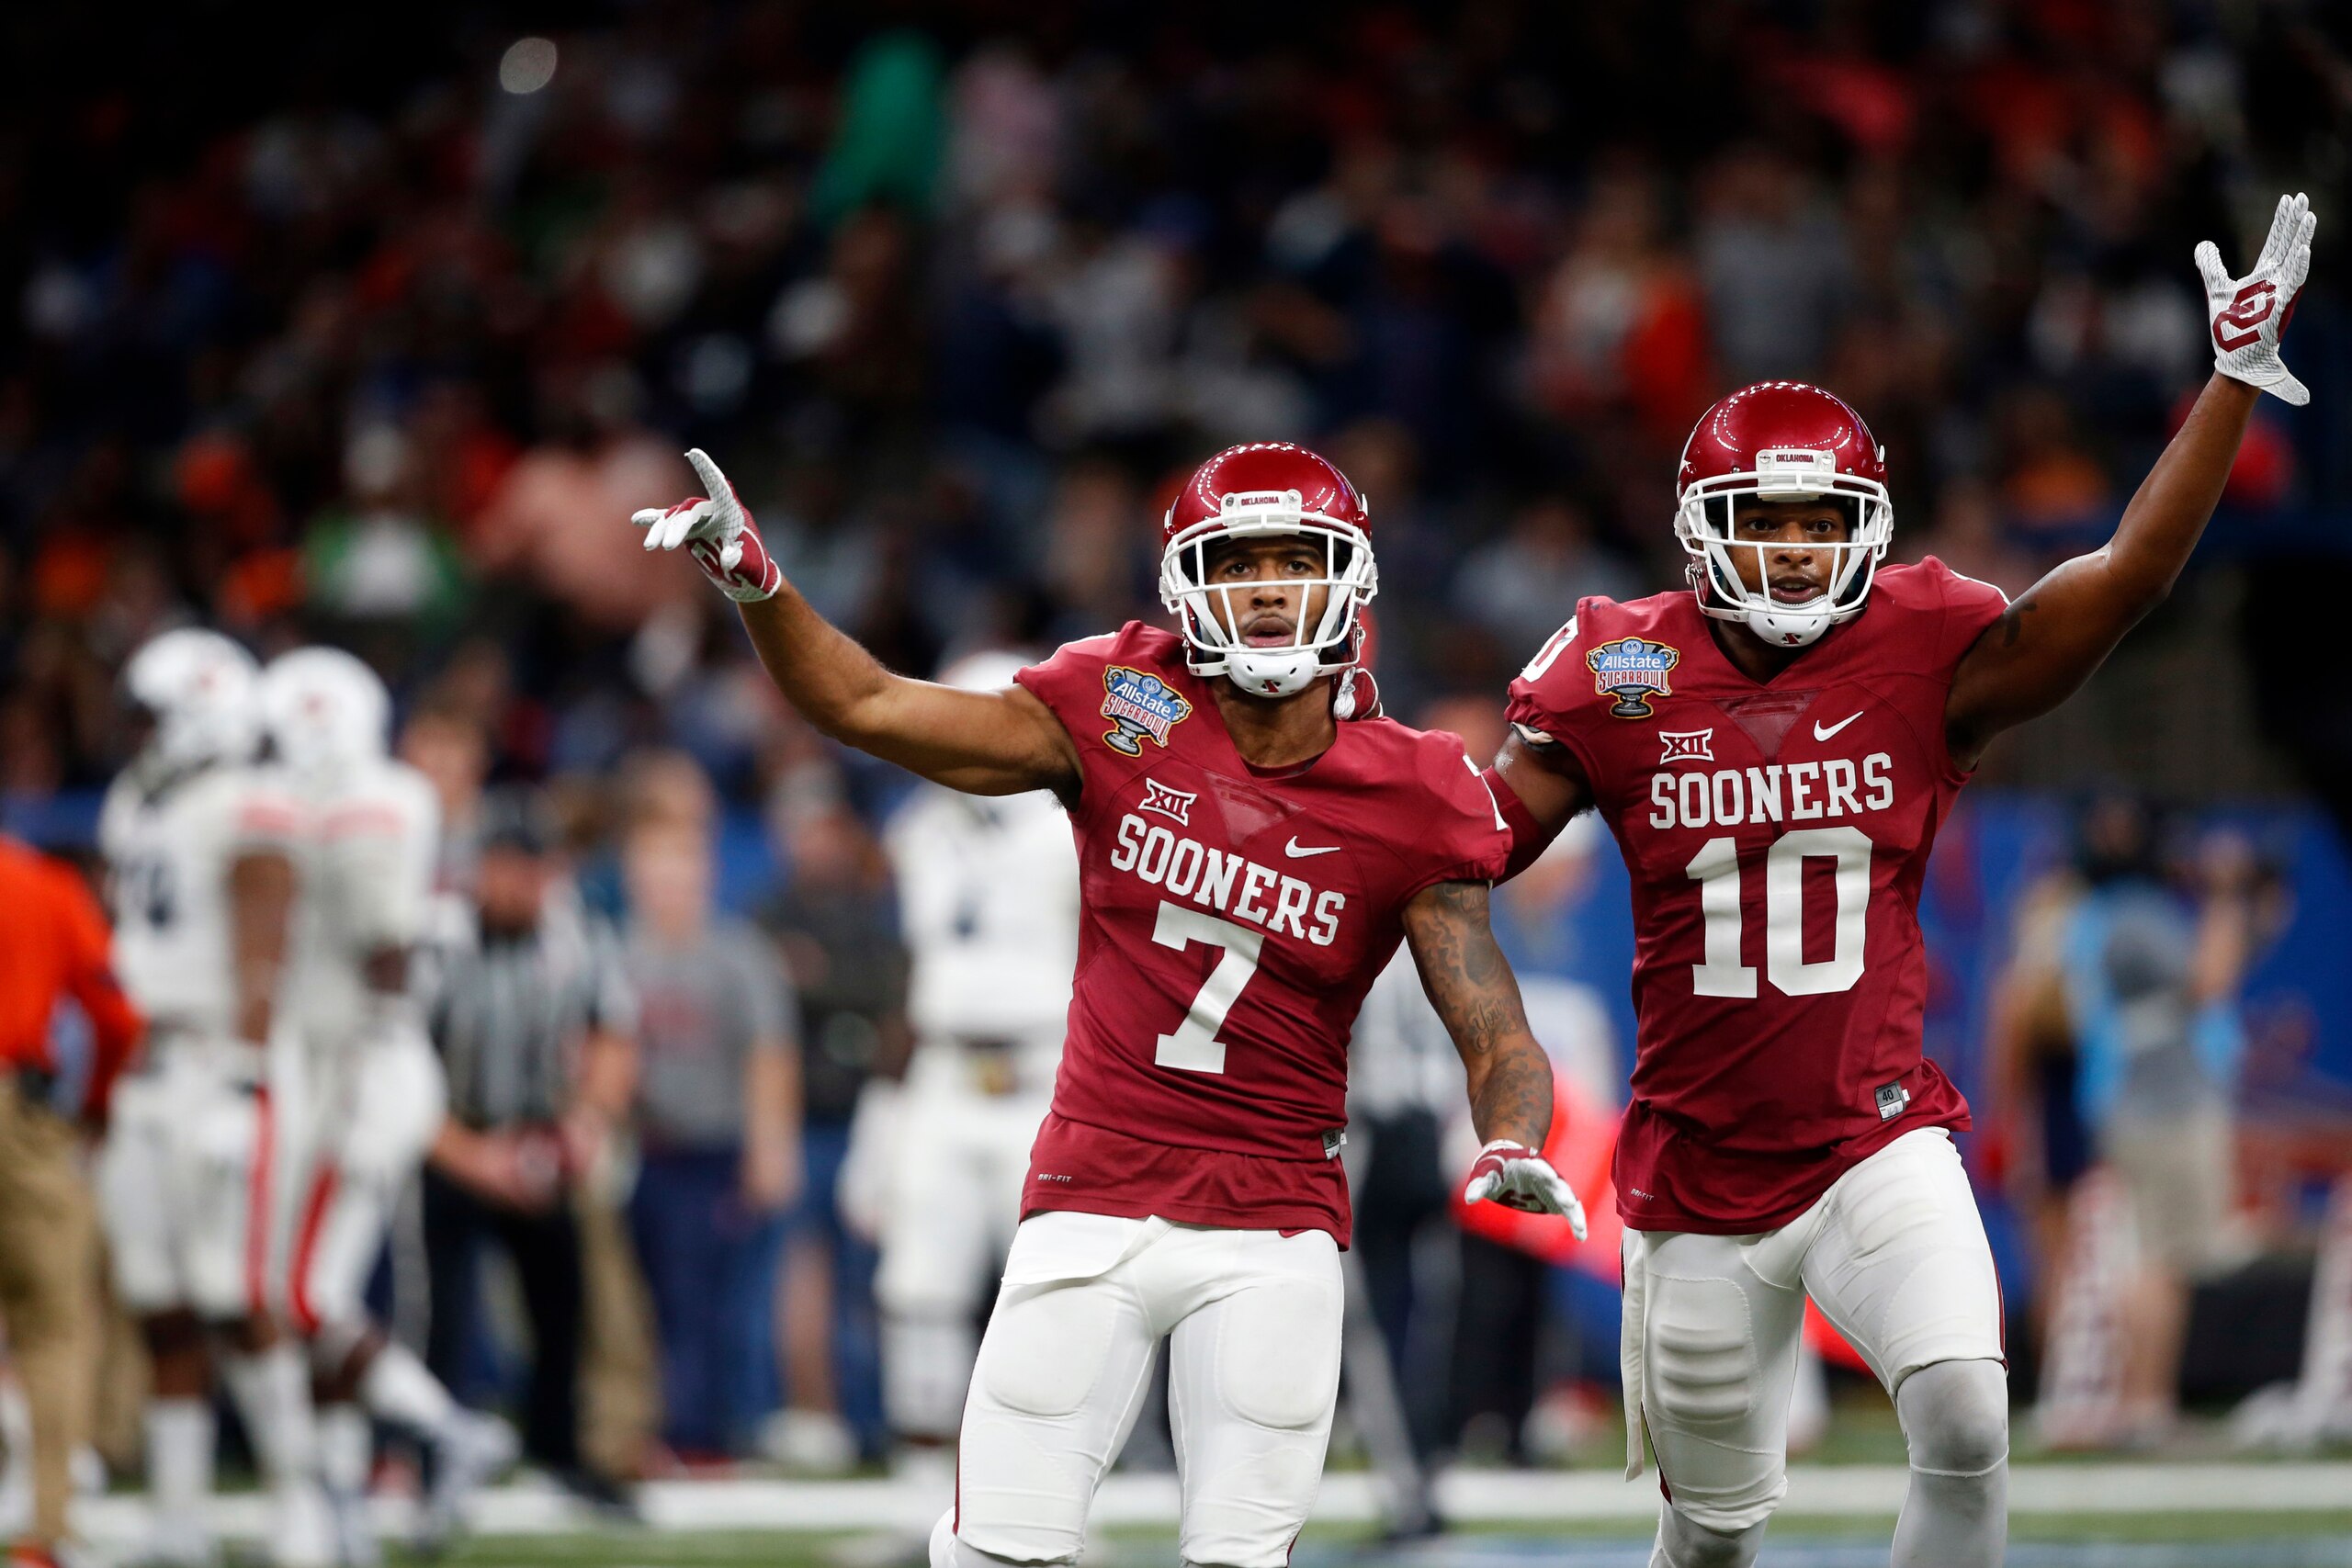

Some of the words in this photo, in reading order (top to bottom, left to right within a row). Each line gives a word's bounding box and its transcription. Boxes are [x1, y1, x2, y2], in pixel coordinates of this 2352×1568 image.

[1776, 454, 1814, 463] OKLAHOMA
[1241, 496, 1279, 506] OKLAHOMA
[1600, 655, 1660, 669] Allstate
[1114, 682, 1170, 716] Allstate
[1649, 751, 1894, 829] SOONERS
[1111, 814, 1345, 946] SOONERS
[1685, 826, 1872, 998] 10
[1151, 900, 1264, 1074] 7
[1883, 1089, 1894, 1101] 40
[1037, 1174, 1072, 1182] DRI-FIT
